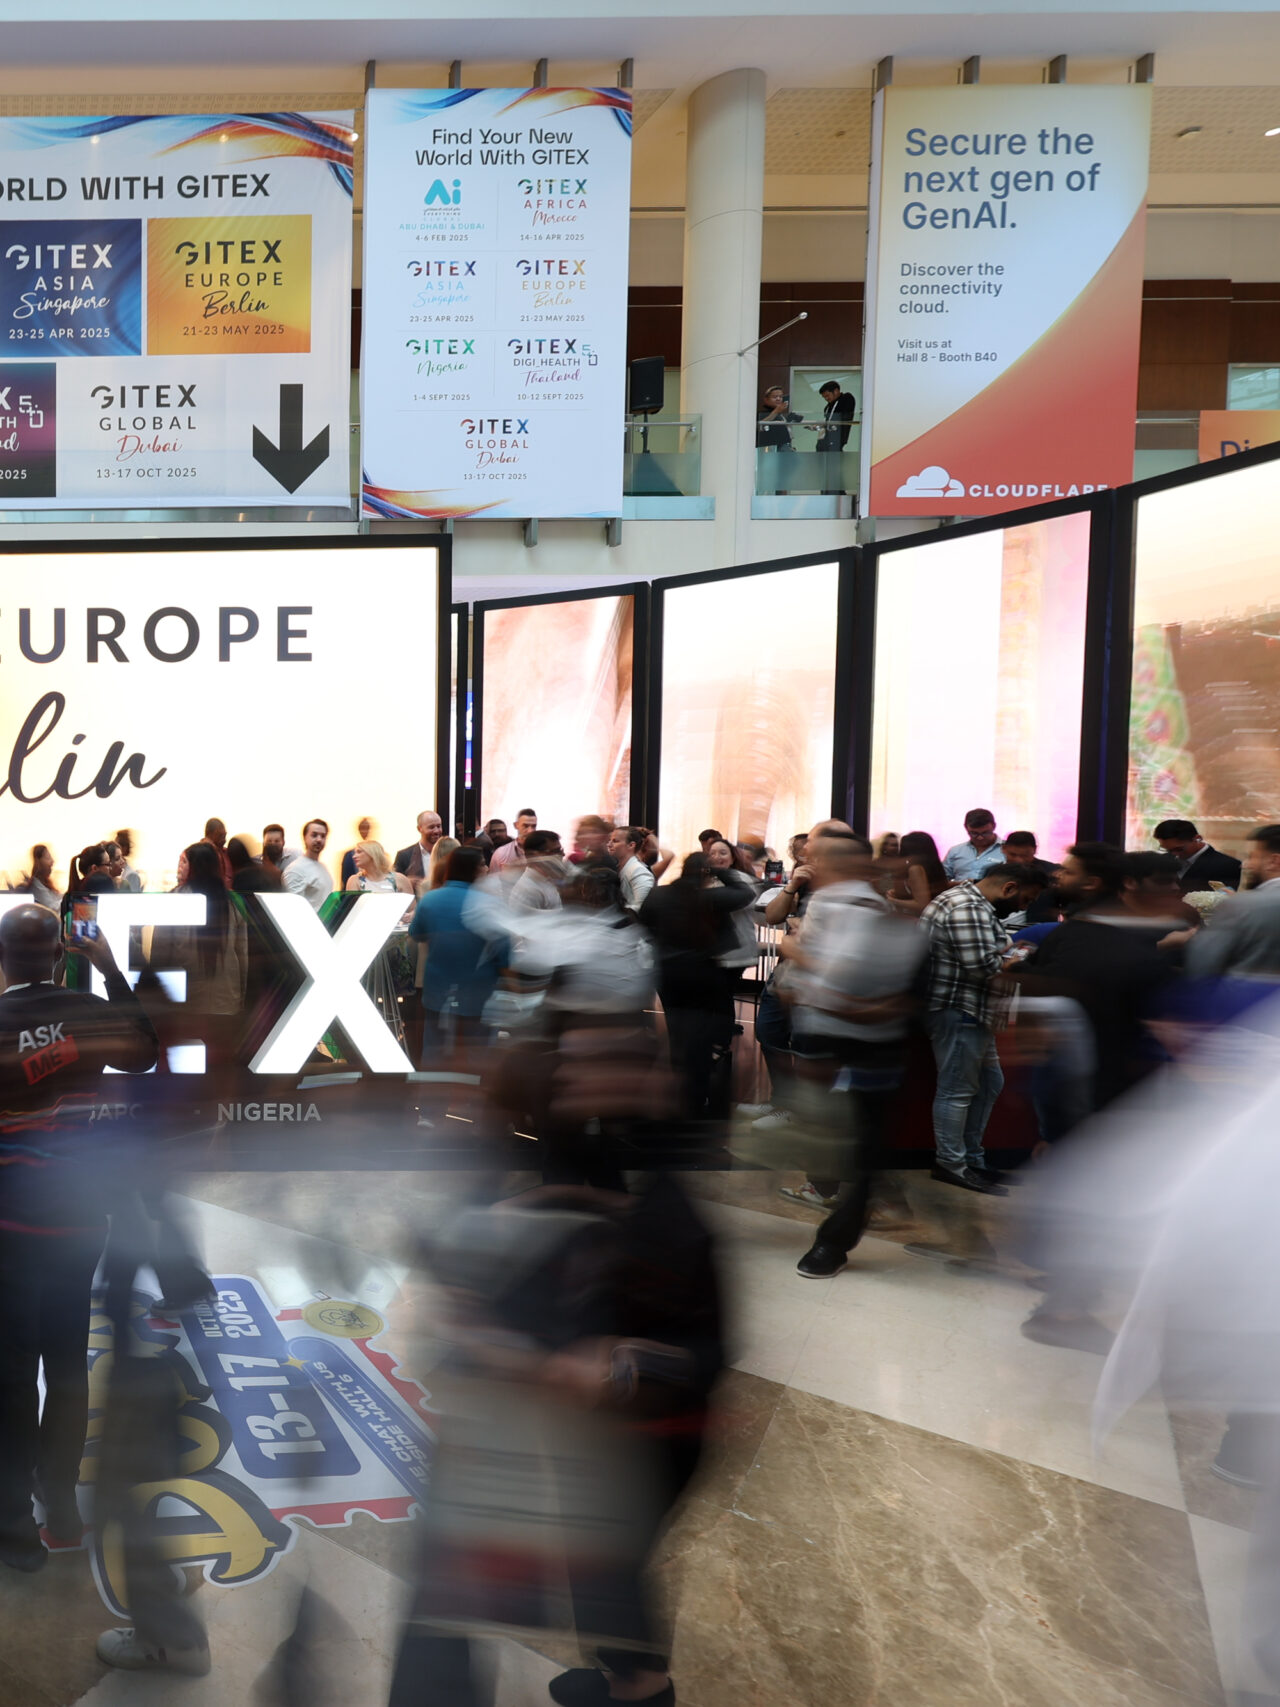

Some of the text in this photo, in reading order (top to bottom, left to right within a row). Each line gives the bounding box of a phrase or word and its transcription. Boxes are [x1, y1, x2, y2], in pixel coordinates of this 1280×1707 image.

[432, 128, 573, 145] Find Your New
[905, 126, 1095, 157] Secure the
[415, 149, 589, 166] World With GITEX
[80, 176, 164, 201] WITH
[177, 173, 271, 199] GITEX
[517, 178, 588, 195] GITEX
[903, 162, 1101, 200] next gen of
[524, 199, 587, 209] AFRICA
[532, 209, 578, 227] Morocco
[902, 201, 1017, 230] GenAI.
[5, 243, 113, 270] GITEX
[175, 239, 283, 266] GITEX
[407, 260, 477, 276] GITEX
[515, 259, 587, 276] GITEX
[900, 263, 1005, 277] Discover the
[34, 275, 96, 291] ASIA
[185, 271, 284, 288] EUROPE
[425, 280, 464, 290] ASIA
[521, 280, 586, 290] EUROPE
[899, 280, 1003, 297] connectivity
[13, 291, 111, 319] Singapore
[201, 289, 270, 319] Berlin
[412, 291, 469, 308] Singapore
[533, 290, 574, 308] Berlin
[899, 300, 949, 314] cloud.
[8, 327, 111, 340] 23-25 APR 2025
[183, 323, 285, 337] 21-23 MAY 2025
[405, 339, 475, 355] GITEX
[507, 338, 577, 355] GITEX
[898, 339, 952, 349] Visit us at
[897, 352, 997, 362] Hall 8 Booth B40
[416, 359, 469, 377] Nigeria
[520, 369, 582, 387] Thailand
[90, 384, 197, 410] GITEX
[99, 416, 197, 431] GLOBAL
[460, 418, 530, 435] GITEX
[116, 433, 183, 462] Dubai
[465, 439, 529, 449] GLOBAL
[475, 451, 520, 469] Dubai
[96, 466, 198, 479] 13-17 OCT 2025
[18, 1022, 66, 1053] ASK
[28, 1046, 64, 1080] ME
[217, 1102, 323, 1122] NIGERIA
[220, 1354, 328, 1464] 13-17
[313, 1361, 413, 1463] CHAT WITH US
[353, 1385, 393, 1423] HALL
